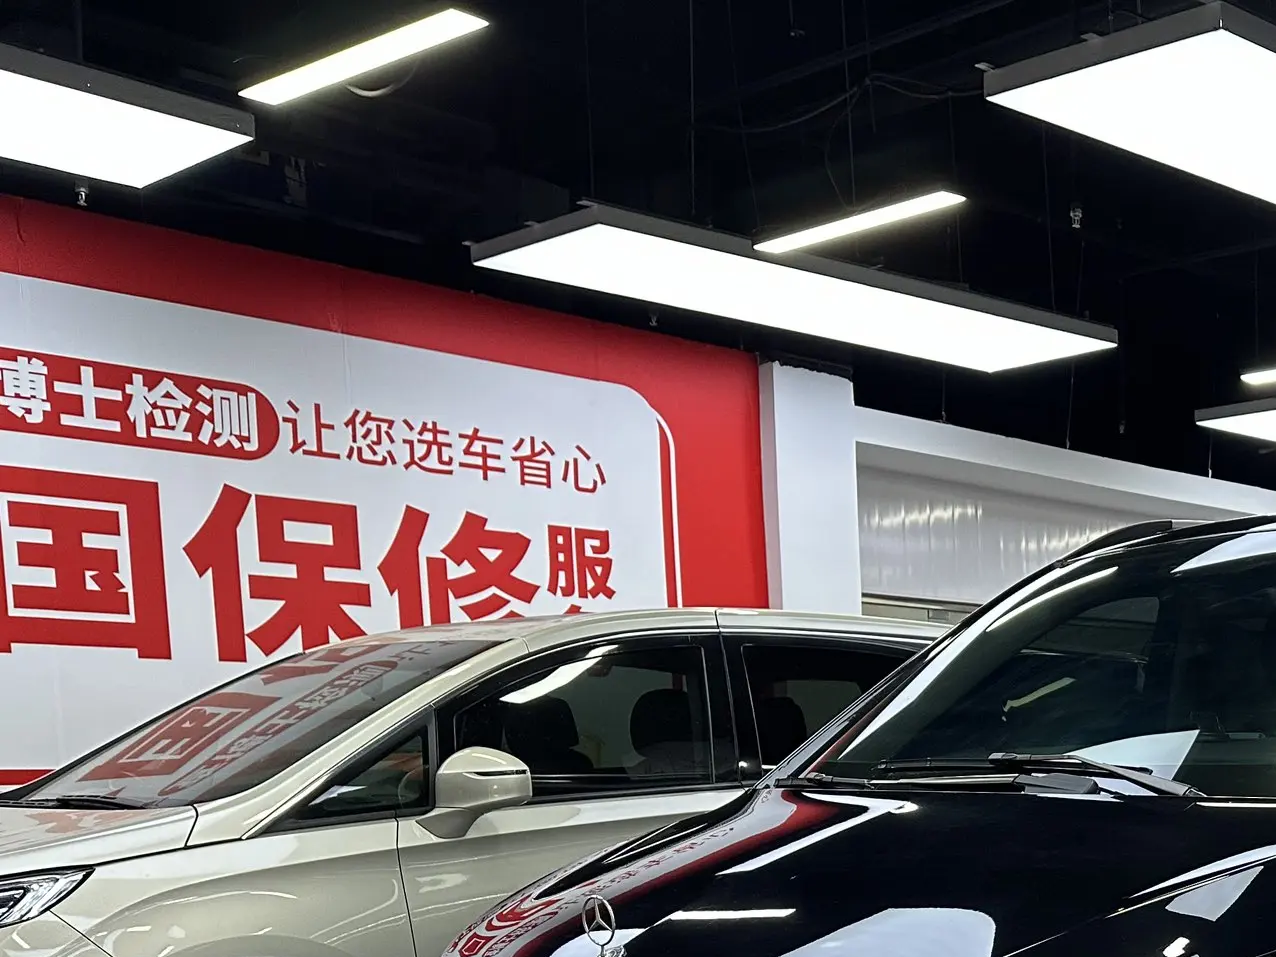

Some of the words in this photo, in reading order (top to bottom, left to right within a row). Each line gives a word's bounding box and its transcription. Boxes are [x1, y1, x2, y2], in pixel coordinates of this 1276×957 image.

[0, 356, 260, 452] 博士检测
[281, 399, 608, 494] 让您选车省心
